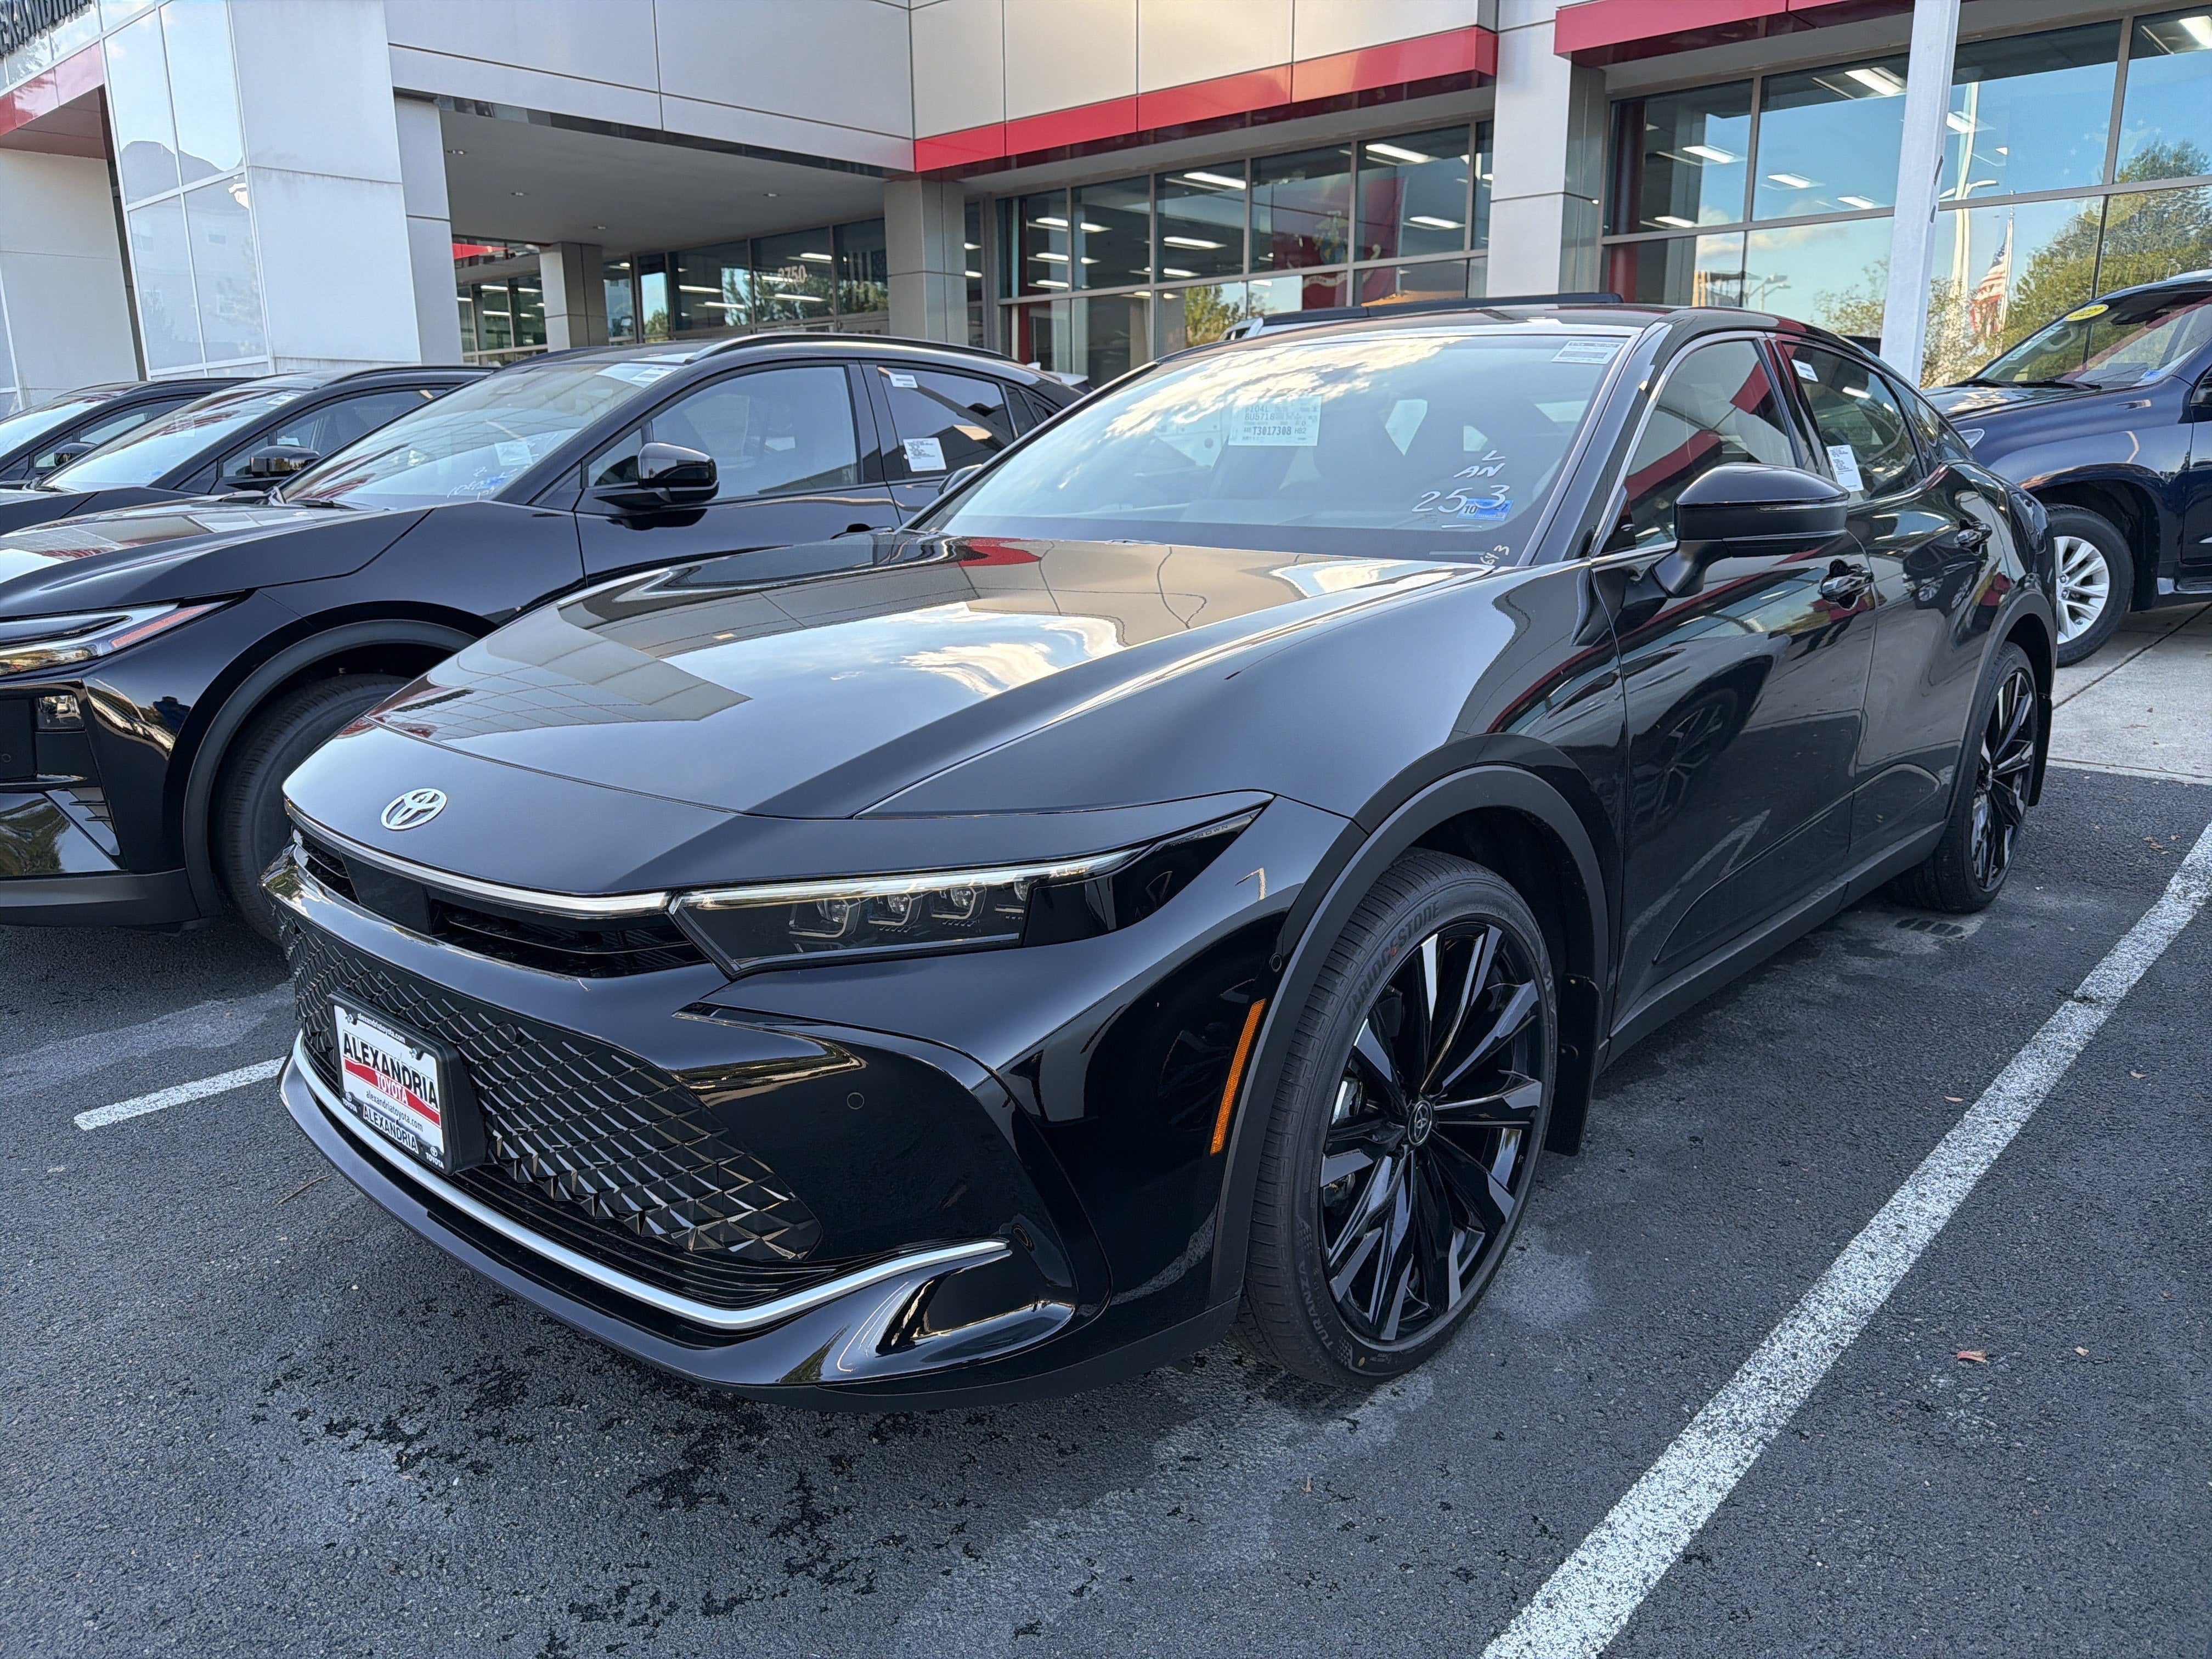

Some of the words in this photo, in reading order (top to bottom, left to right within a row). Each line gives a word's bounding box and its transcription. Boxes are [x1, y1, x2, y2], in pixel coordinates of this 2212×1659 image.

[1463, 505, 1477, 515] 10
[357, 1012, 405, 1043] alexandriatoyota.com
[343, 1032, 438, 1108] ALEXANDRIA
[375, 1071, 409, 1105] TOYOTA
[342, 1098, 358, 1113] TOYOTA
[366, 1090, 423, 1132] alexandriatoyota.com
[363, 1104, 419, 1154] ALEXANDRIA
[425, 1152, 444, 1169] TOYOTA
